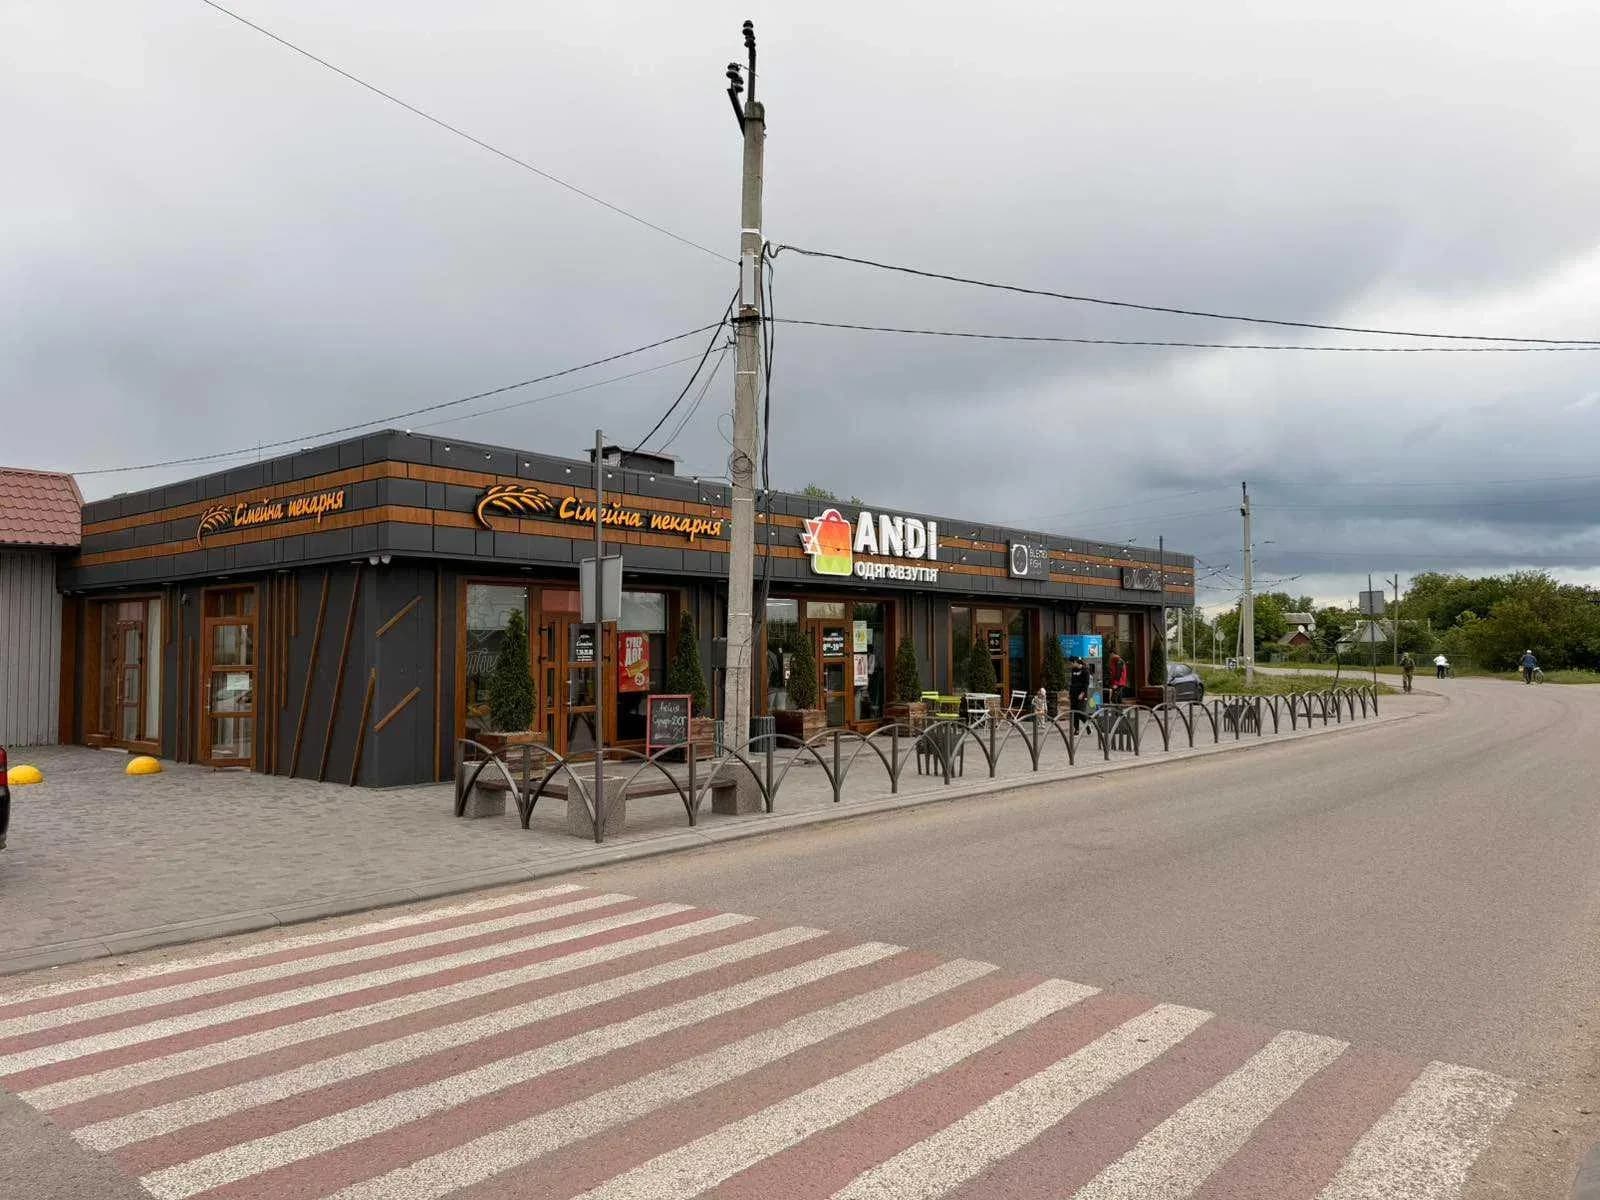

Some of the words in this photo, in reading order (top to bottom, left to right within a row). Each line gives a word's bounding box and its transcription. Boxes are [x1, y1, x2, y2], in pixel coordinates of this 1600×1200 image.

[233, 497, 284, 527] Сімейна
[288, 490, 345, 524] пекарня
[558, 496, 642, 527] Сімейна
[650, 516, 722, 542] пекарня
[853, 510, 938, 561] ANDI
